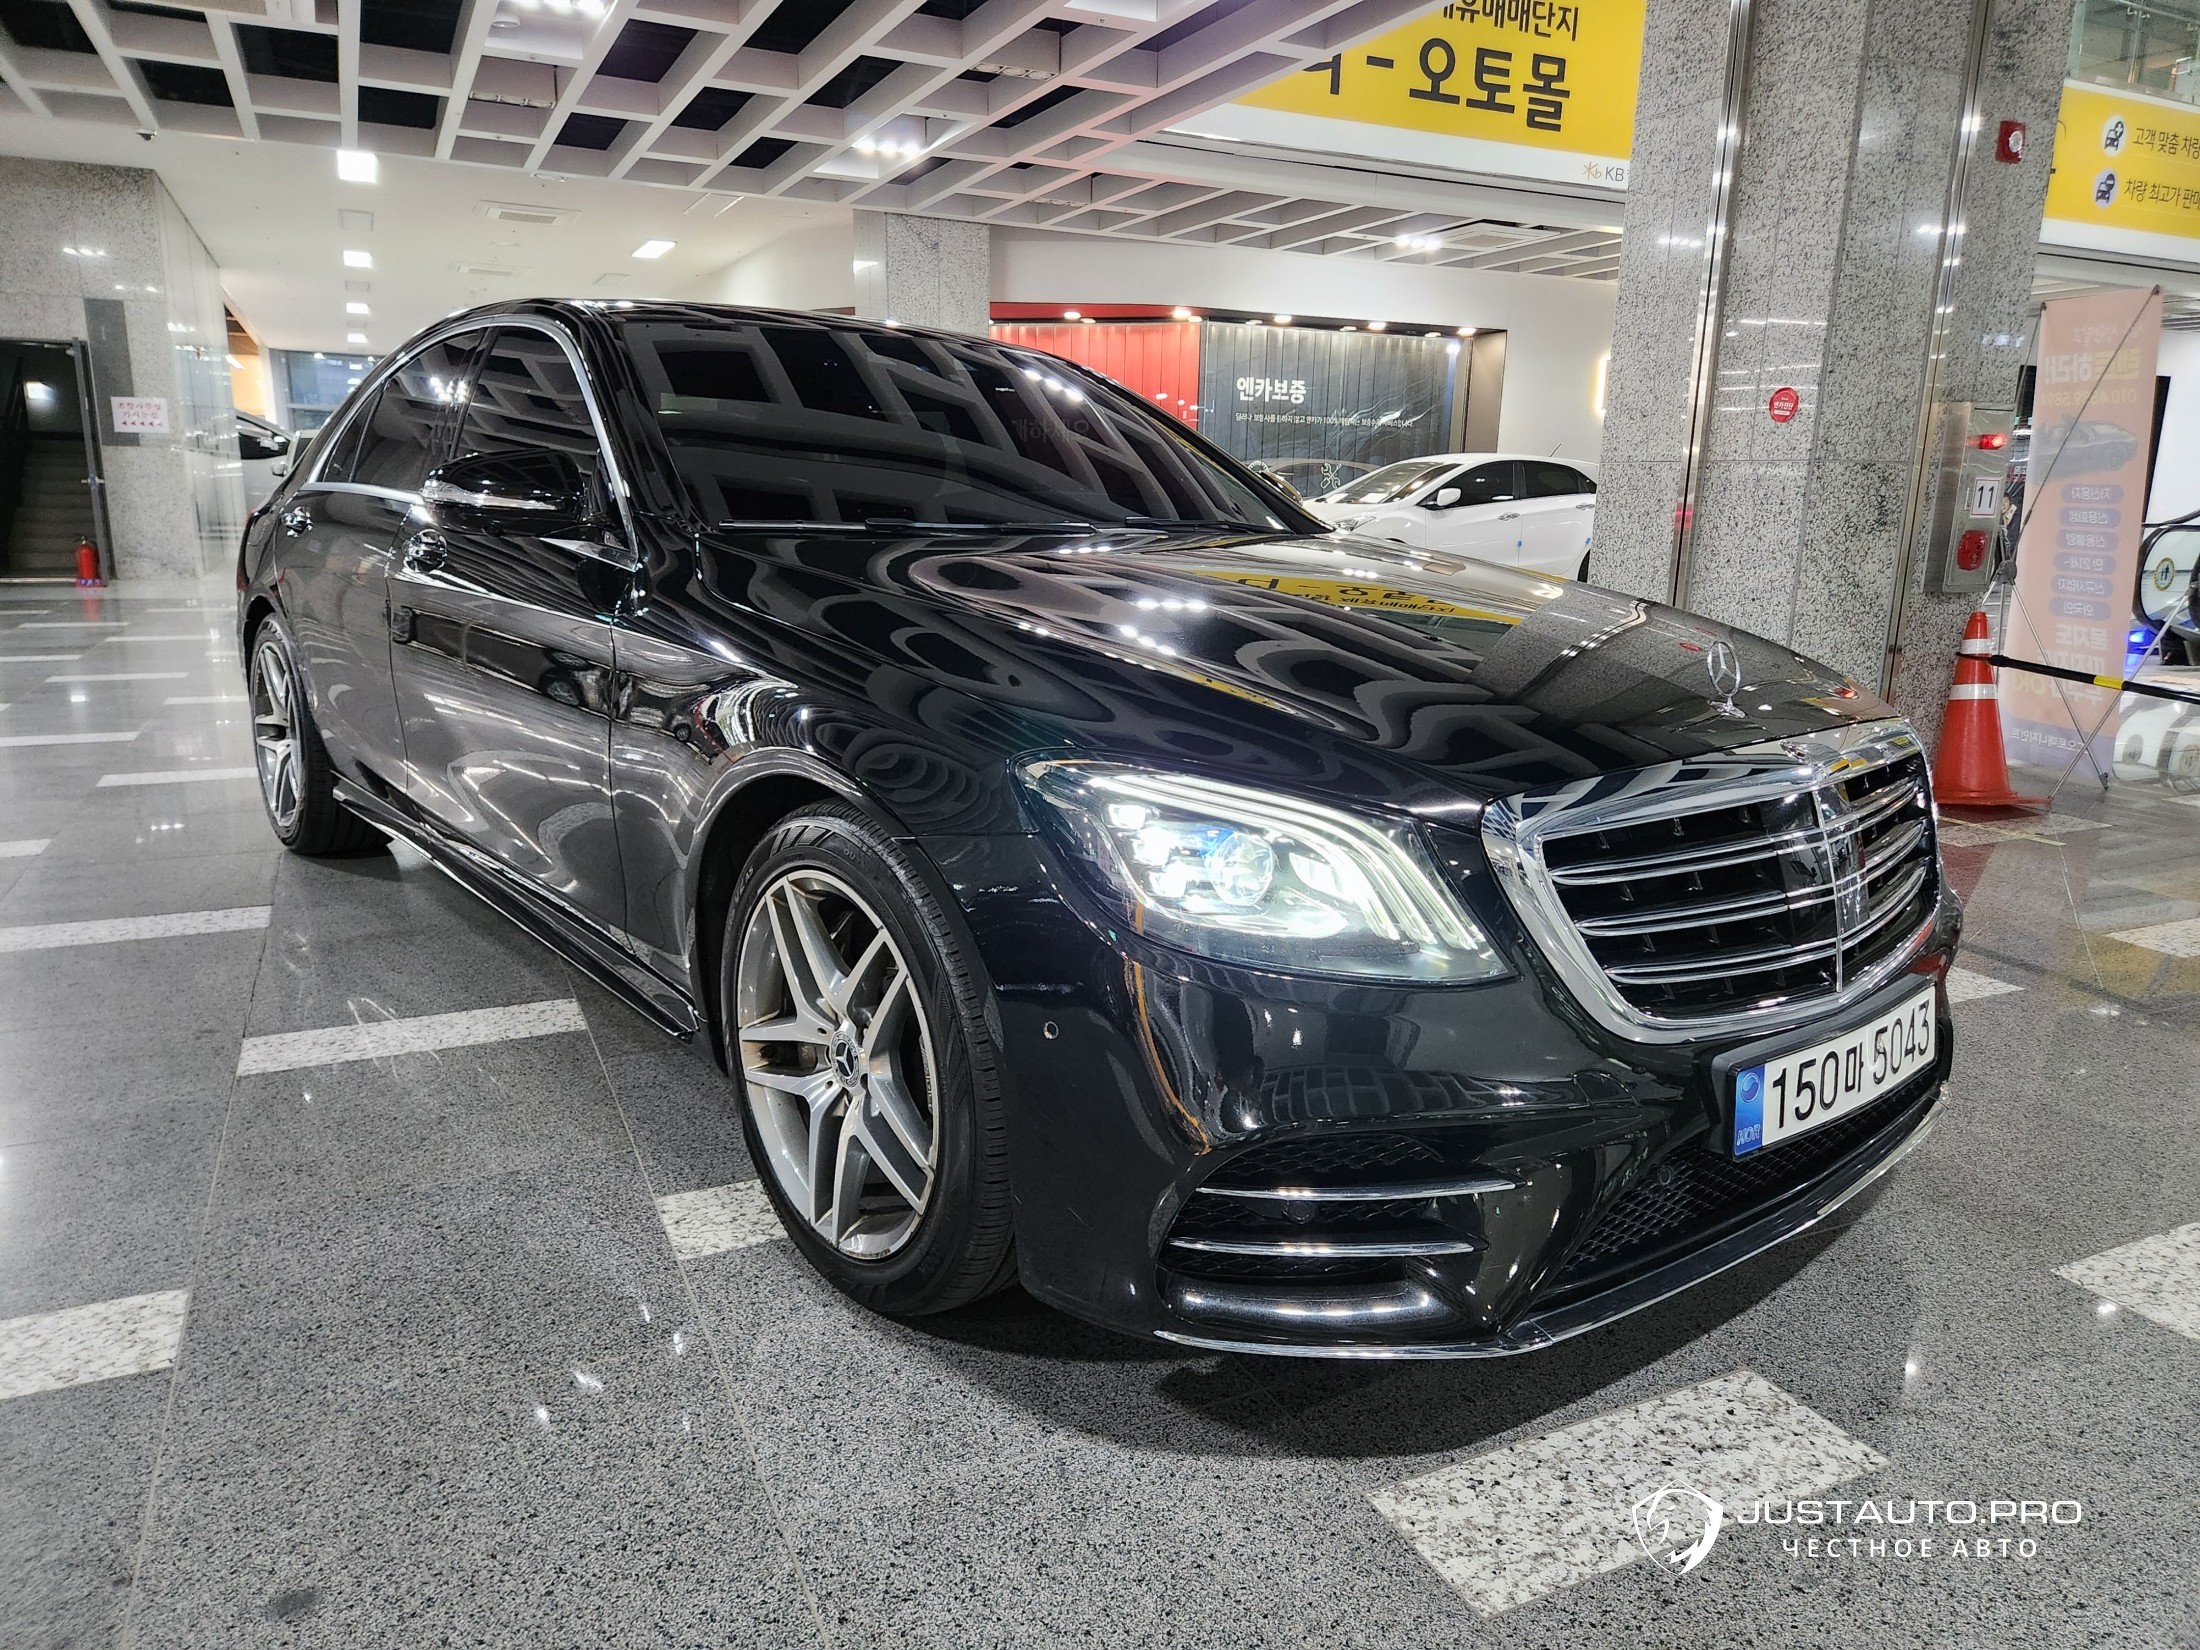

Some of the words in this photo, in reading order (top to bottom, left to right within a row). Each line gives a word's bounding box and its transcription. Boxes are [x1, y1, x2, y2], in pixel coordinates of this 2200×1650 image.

[1408, 37, 1571, 133] 오토몰
[2132, 127, 2156, 151] 고객
[2157, 131, 2180, 155] 맞춤
[1605, 166, 1625, 182] KB
[2123, 178, 2148, 203] 차량
[2148, 182, 2181, 208] 최고가
[1236, 376, 1307, 404] 엔카보증
[1977, 485, 1995, 509] 11
[1771, 1041, 1864, 1129] 150마
[1872, 999, 1930, 1085] 5043
[1736, 1123, 1760, 1146] KOR
